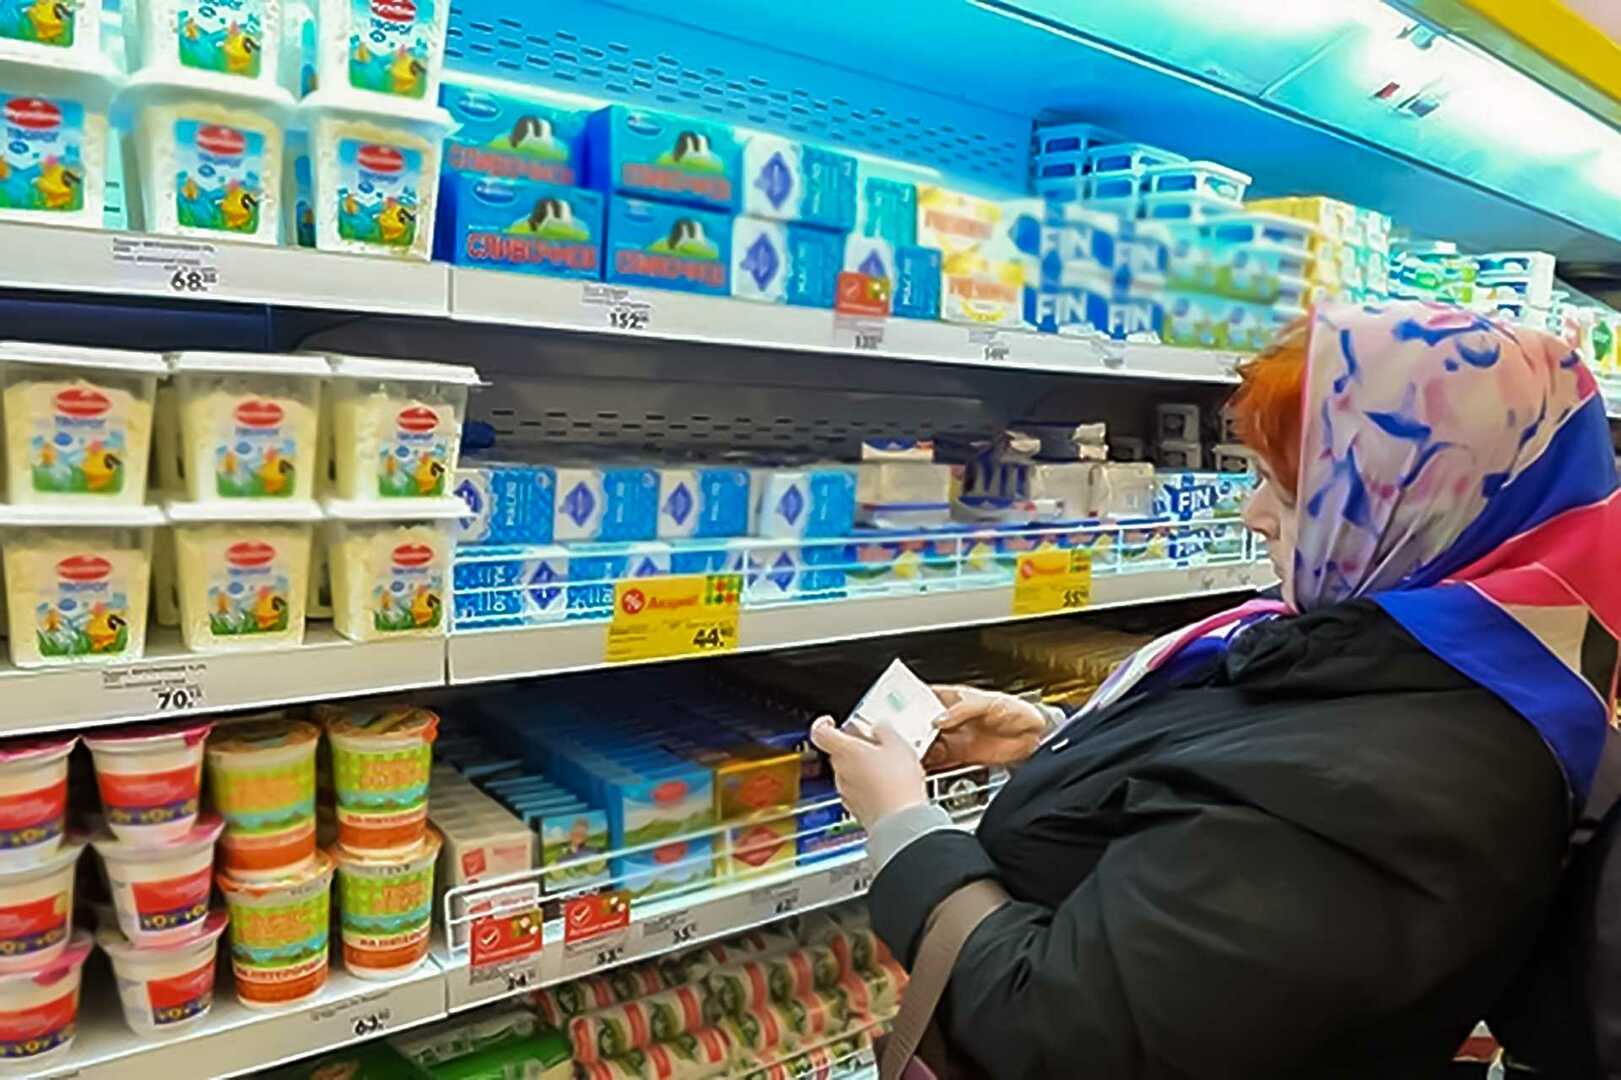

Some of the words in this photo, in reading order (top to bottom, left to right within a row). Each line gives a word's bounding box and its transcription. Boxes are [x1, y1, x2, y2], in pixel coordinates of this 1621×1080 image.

[1041, 227, 1091, 259] FIN
[1037, 293, 1086, 324] FIN
[1178, 487, 1212, 512] FIN
